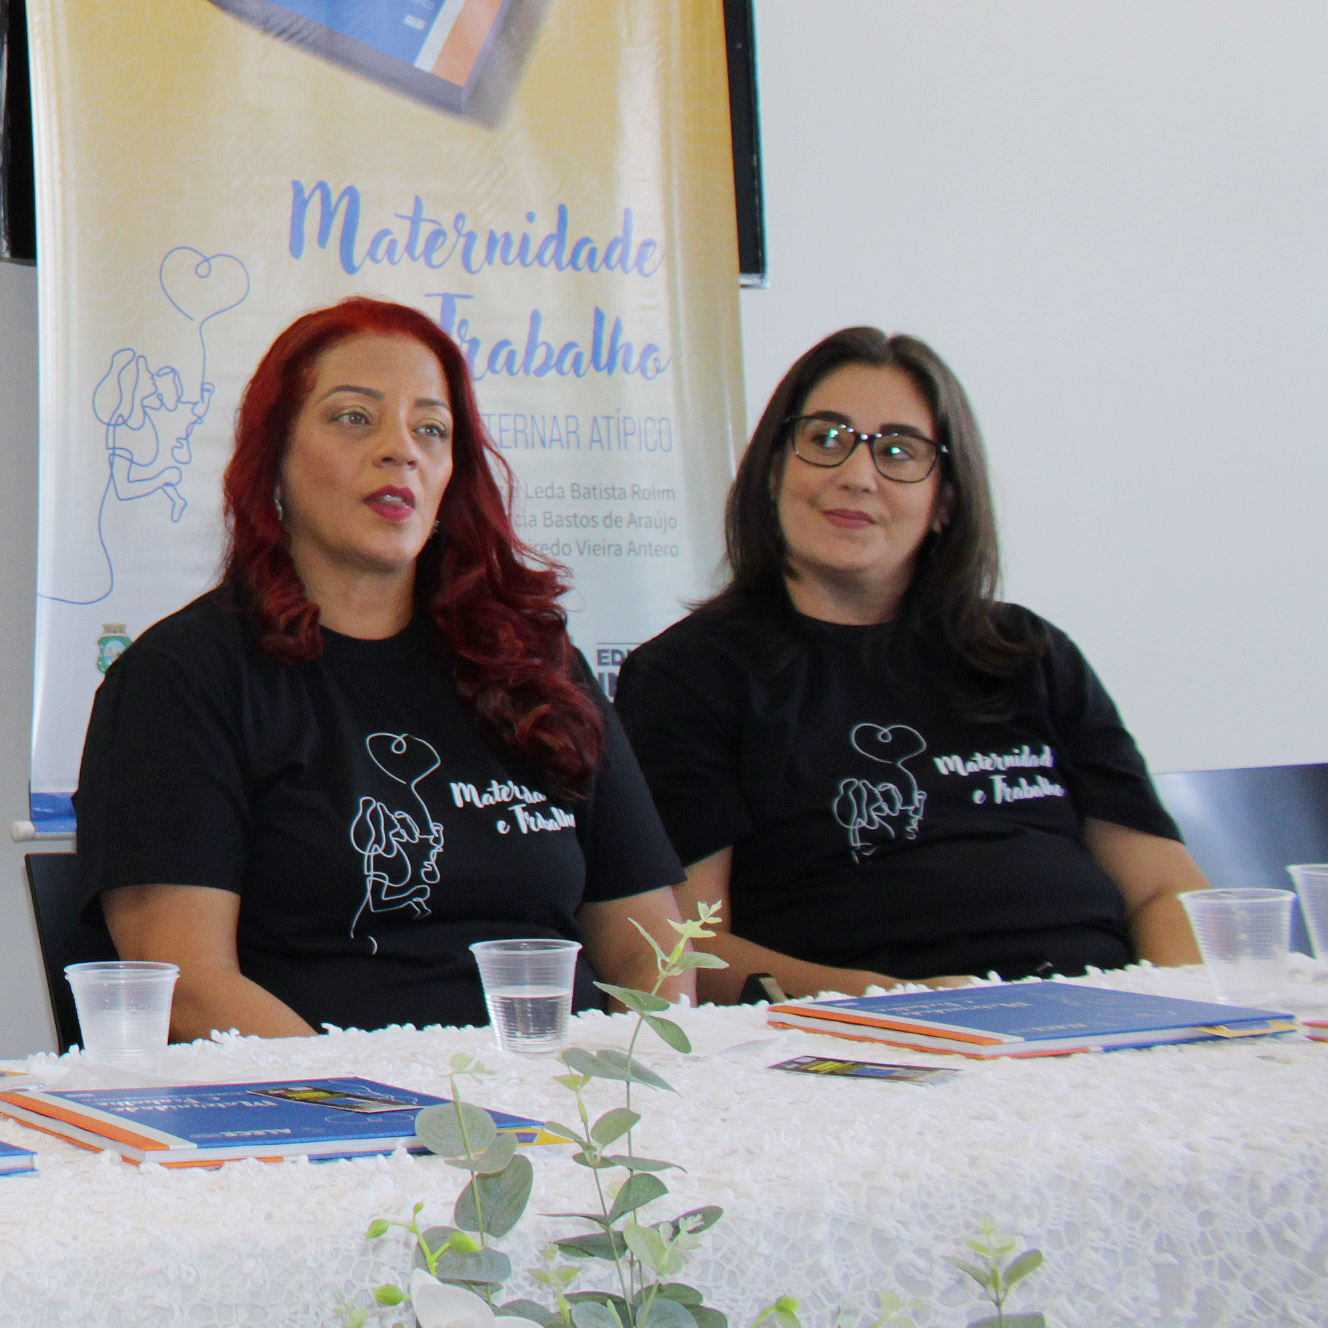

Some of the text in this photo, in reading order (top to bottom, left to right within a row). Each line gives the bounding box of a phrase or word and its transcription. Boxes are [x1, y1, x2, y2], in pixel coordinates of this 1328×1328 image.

[289, 179, 666, 278] Maternidade
[424, 292, 674, 382] Trabalho
[482, 408, 673, 453] TERNAR ATÍPICO
[525, 482, 566, 500] Leda
[570, 482, 627, 501] Batista
[631, 483, 676, 501] Rolim
[543, 511, 598, 529] Bastos
[602, 511, 624, 529] de
[627, 510, 678, 534] Araújo
[576, 539, 623, 557] Vieira
[627, 540, 680, 558] Antero
[932, 744, 1055, 776] Maternidad
[496, 819, 511, 834] e
